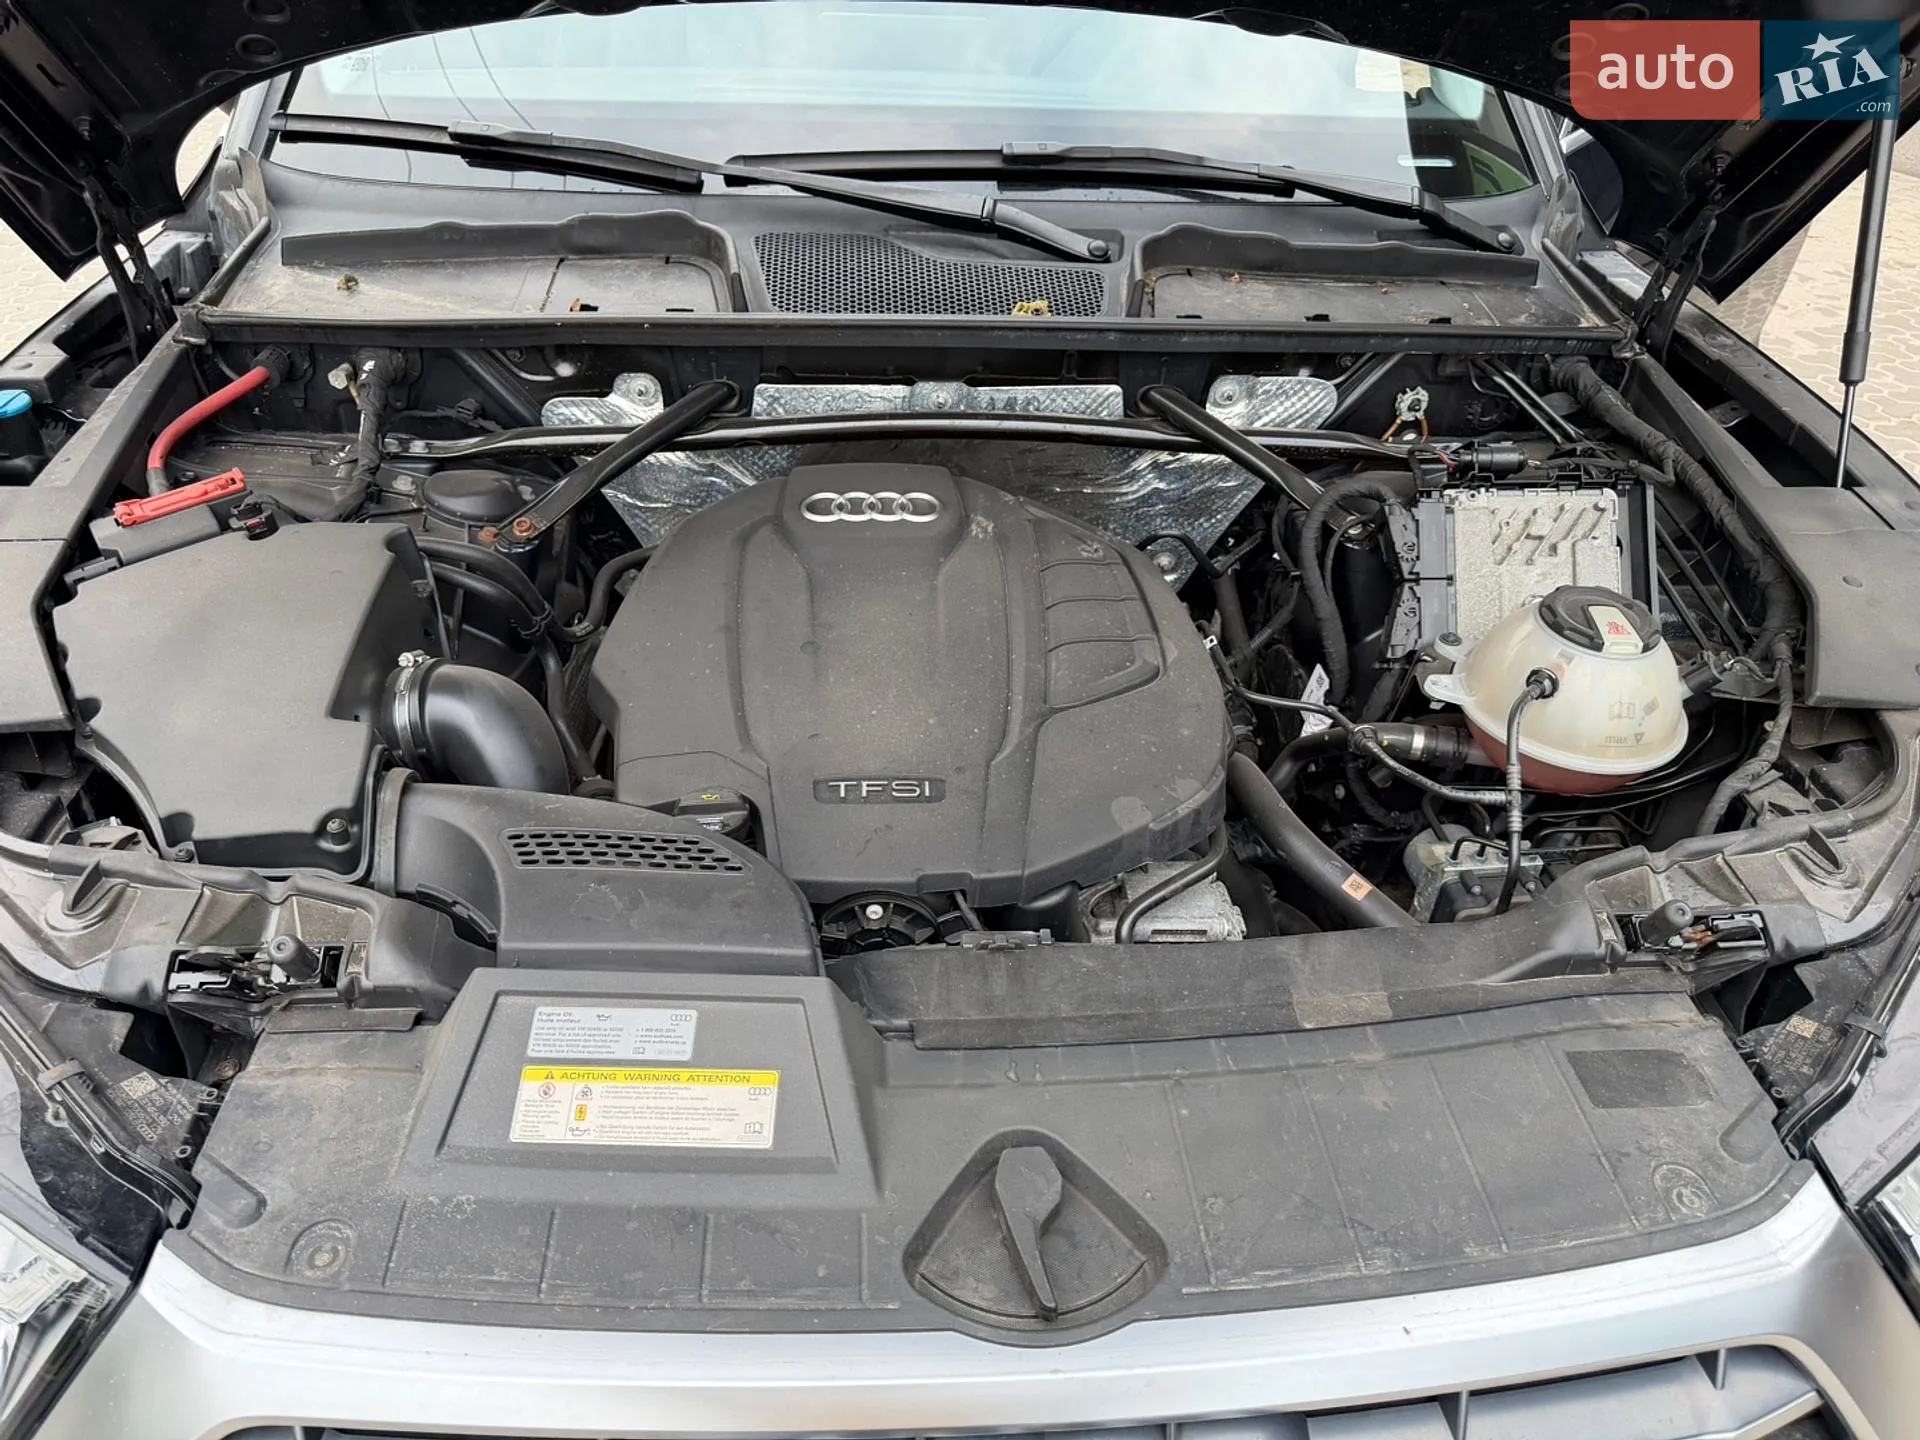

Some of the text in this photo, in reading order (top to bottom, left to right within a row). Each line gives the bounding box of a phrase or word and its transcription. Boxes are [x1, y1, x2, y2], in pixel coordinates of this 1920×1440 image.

[1604, 734, 1628, 744] max
[828, 780, 930, 798] TFSI
[538, 1010, 561, 1018] Engine
[560, 1072, 751, 1084] ACHTUNG WARNING ATTENTION
